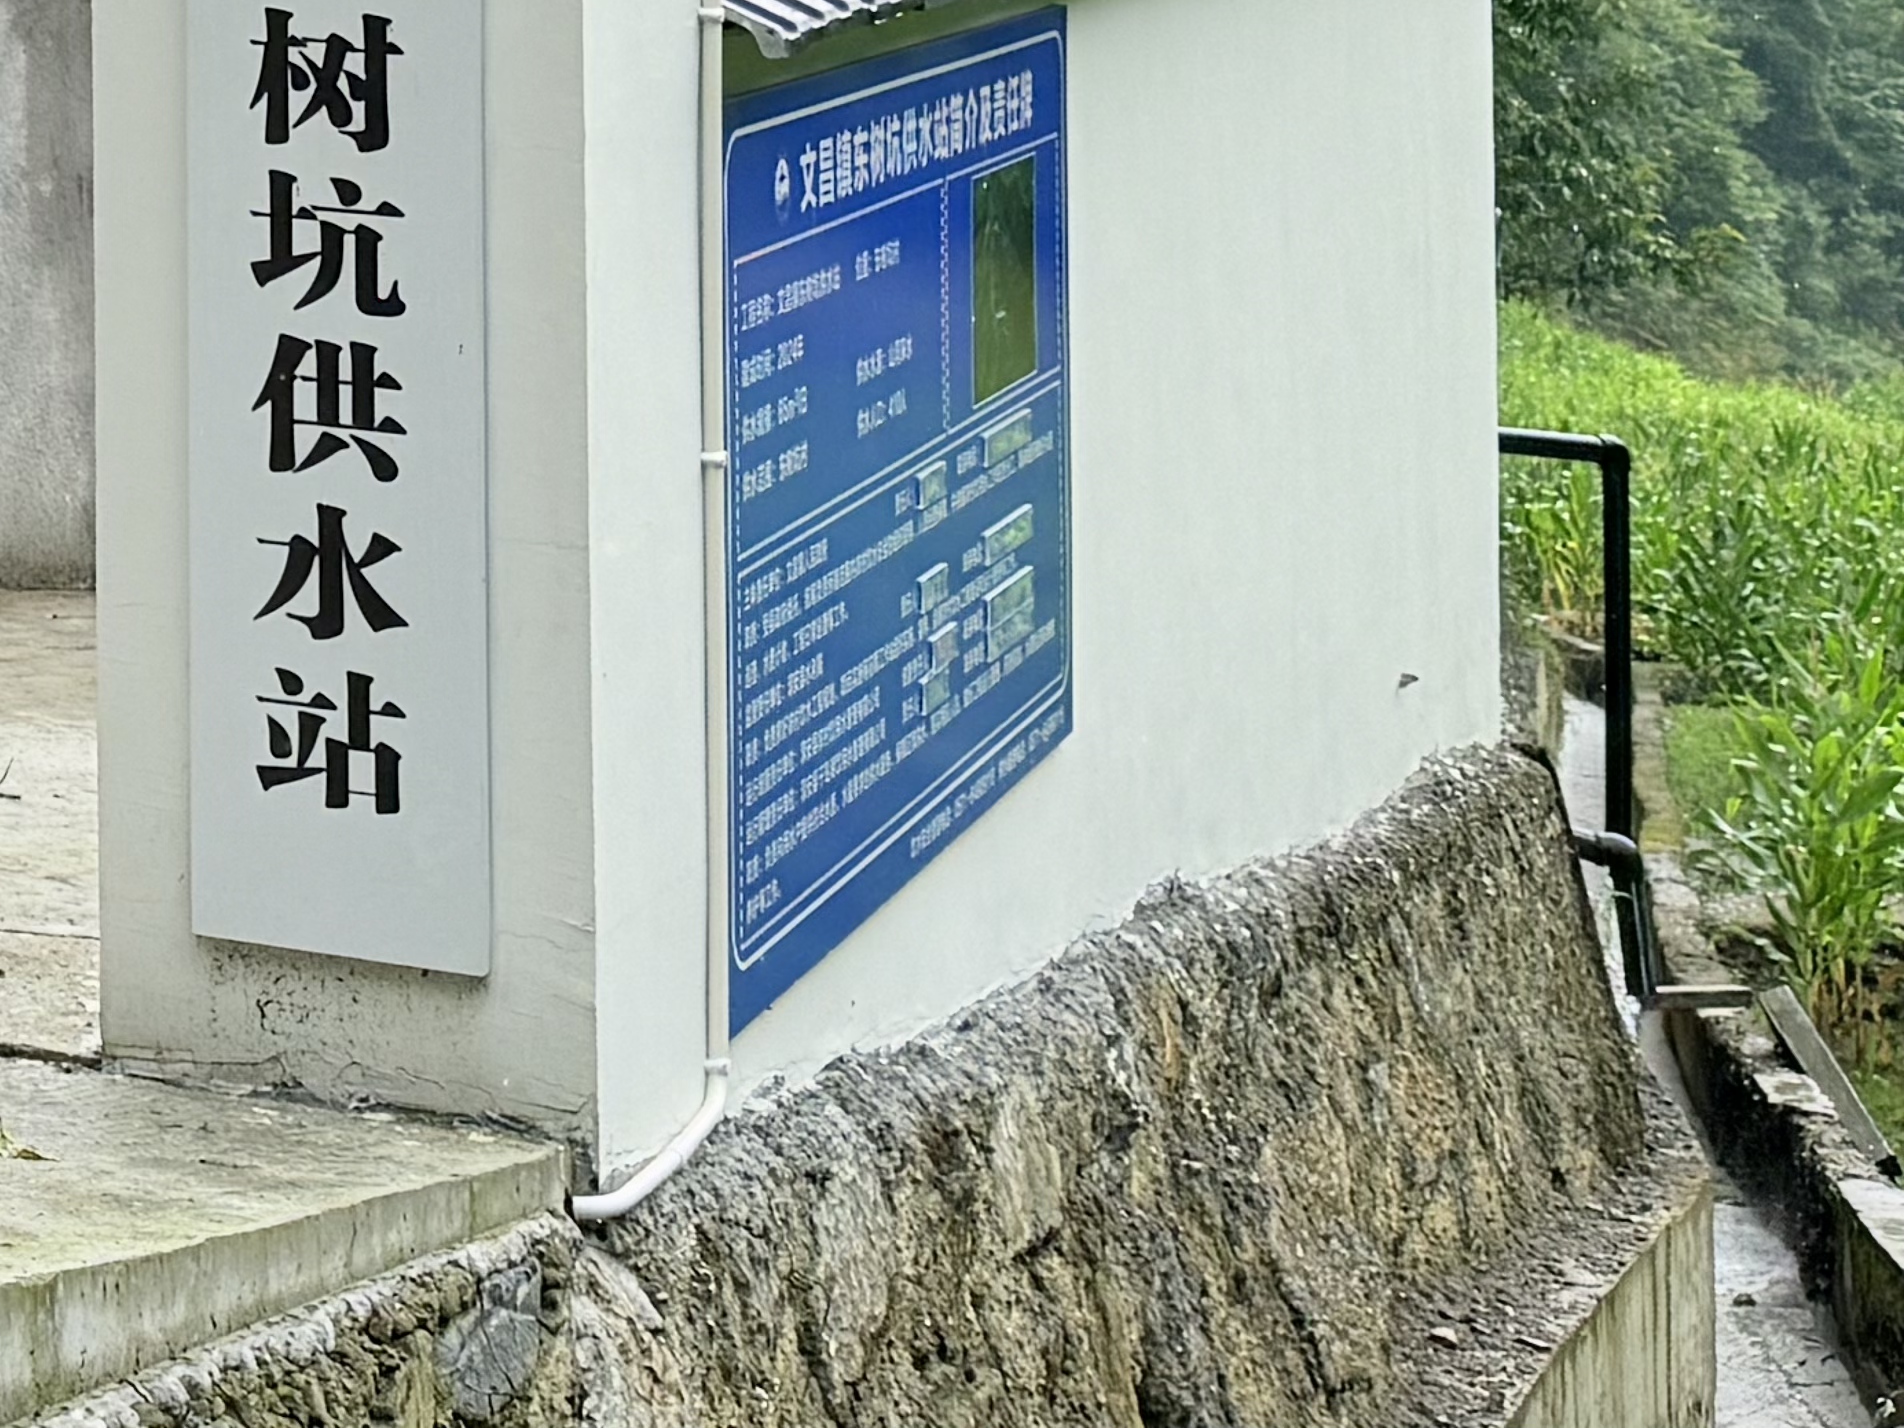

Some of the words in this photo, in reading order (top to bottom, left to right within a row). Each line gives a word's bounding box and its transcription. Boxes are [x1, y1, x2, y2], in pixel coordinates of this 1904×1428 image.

[799, 69, 1033, 213] 文昌镇东树坑供水站简介及责任牌
